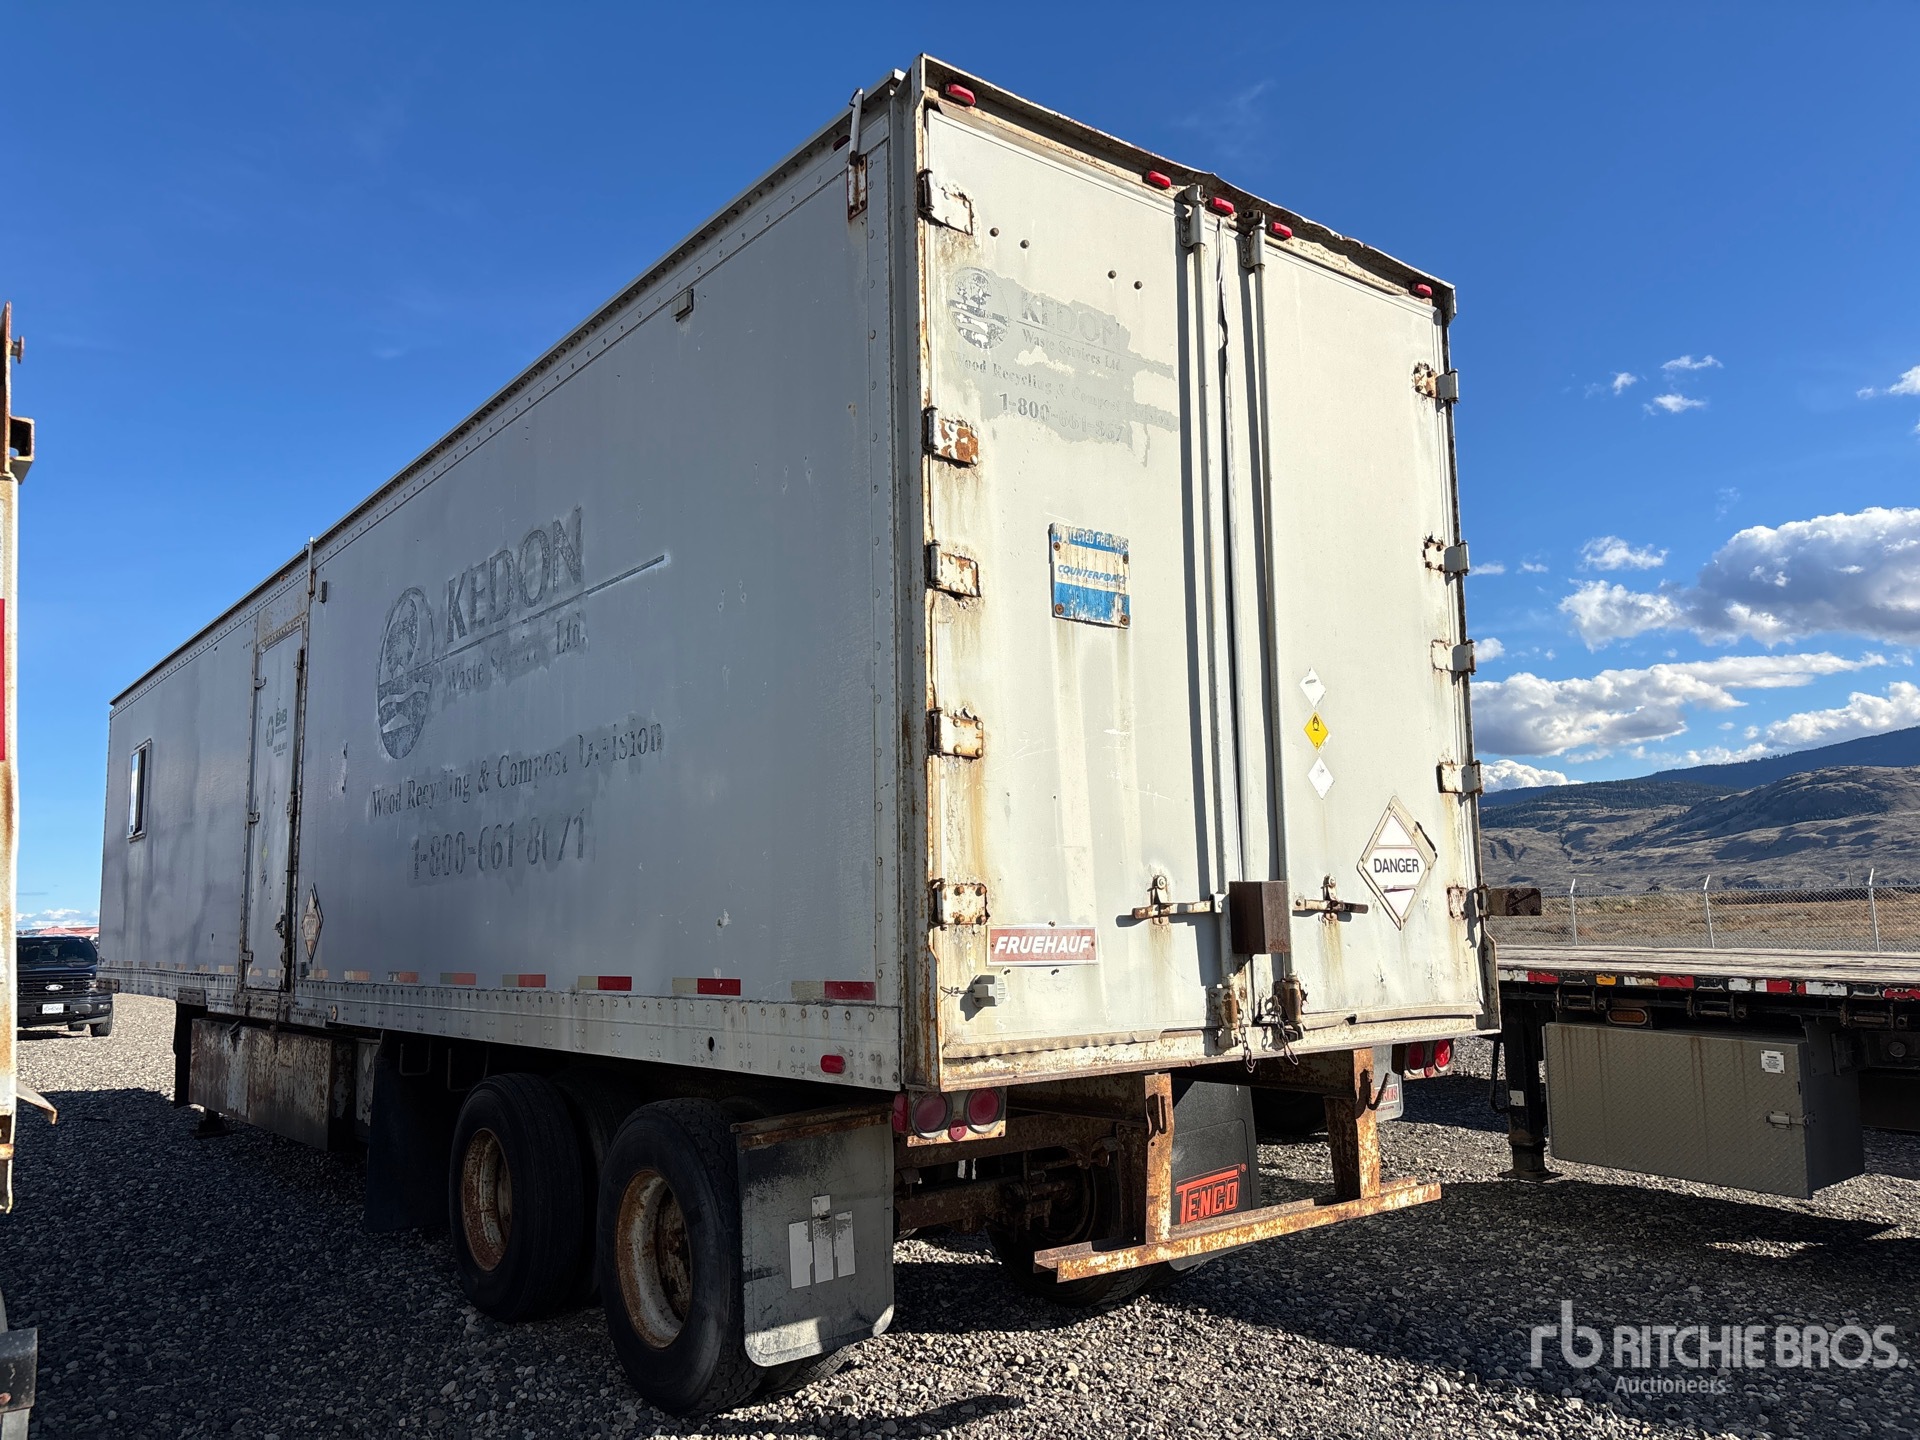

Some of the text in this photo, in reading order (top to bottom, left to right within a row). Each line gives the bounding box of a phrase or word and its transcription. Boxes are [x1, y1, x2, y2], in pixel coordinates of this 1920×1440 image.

[447, 507, 582, 644] KEDON
[407, 768, 472, 810] Recying
[478, 760, 490, 794] &
[1373, 858, 1419, 873] DANGER
[994, 936, 1091, 954] FRUEHAUF
[1174, 1165, 1240, 1225] TENCO
